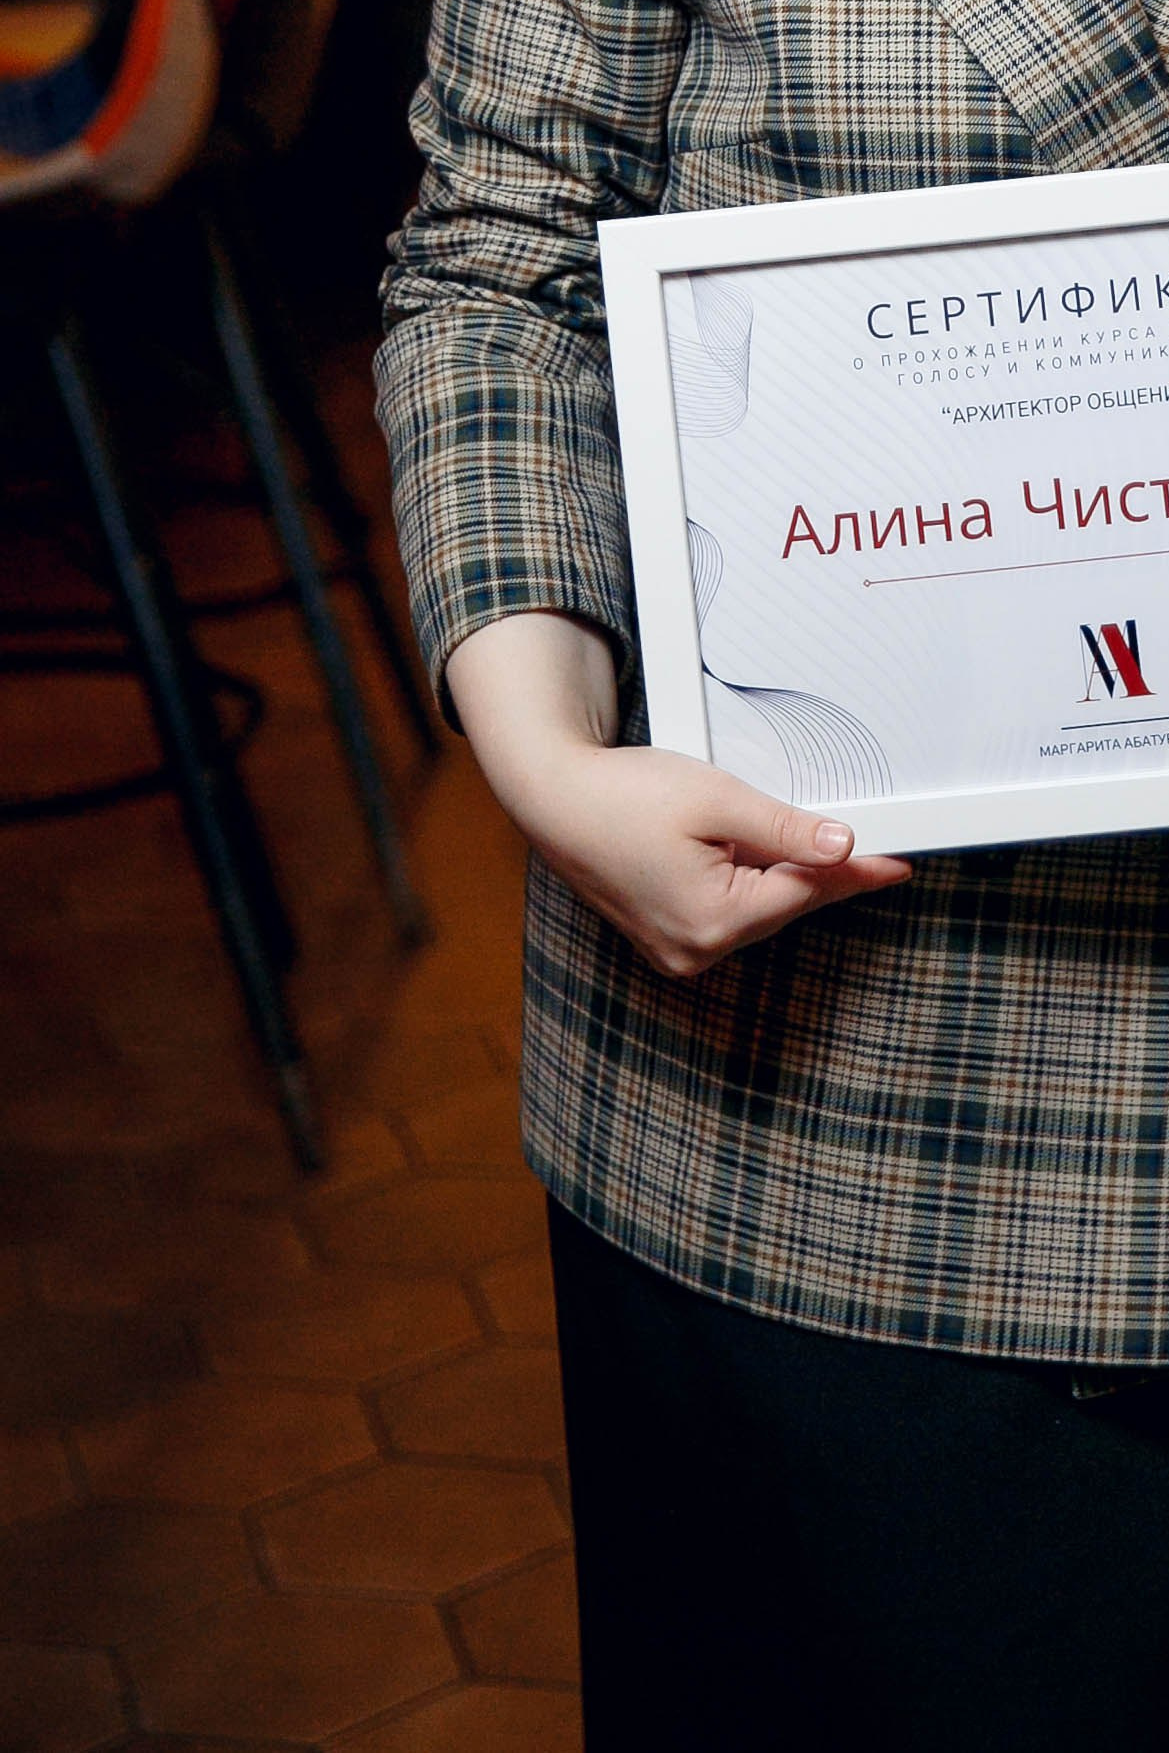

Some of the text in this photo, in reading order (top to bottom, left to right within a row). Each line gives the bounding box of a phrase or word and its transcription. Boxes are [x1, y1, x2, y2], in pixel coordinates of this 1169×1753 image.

[853, 357, 864, 370] О
[881, 336, 1064, 367] ПРОХОЖДЕНИИ
[1080, 326, 1156, 347] КУРСА
[897, 364, 990, 386] ГОЛОСУ
[1007, 361, 1018, 374] И
[781, 496, 994, 559] Алина
[1039, 739, 1122, 758] МАРГАРИТА
